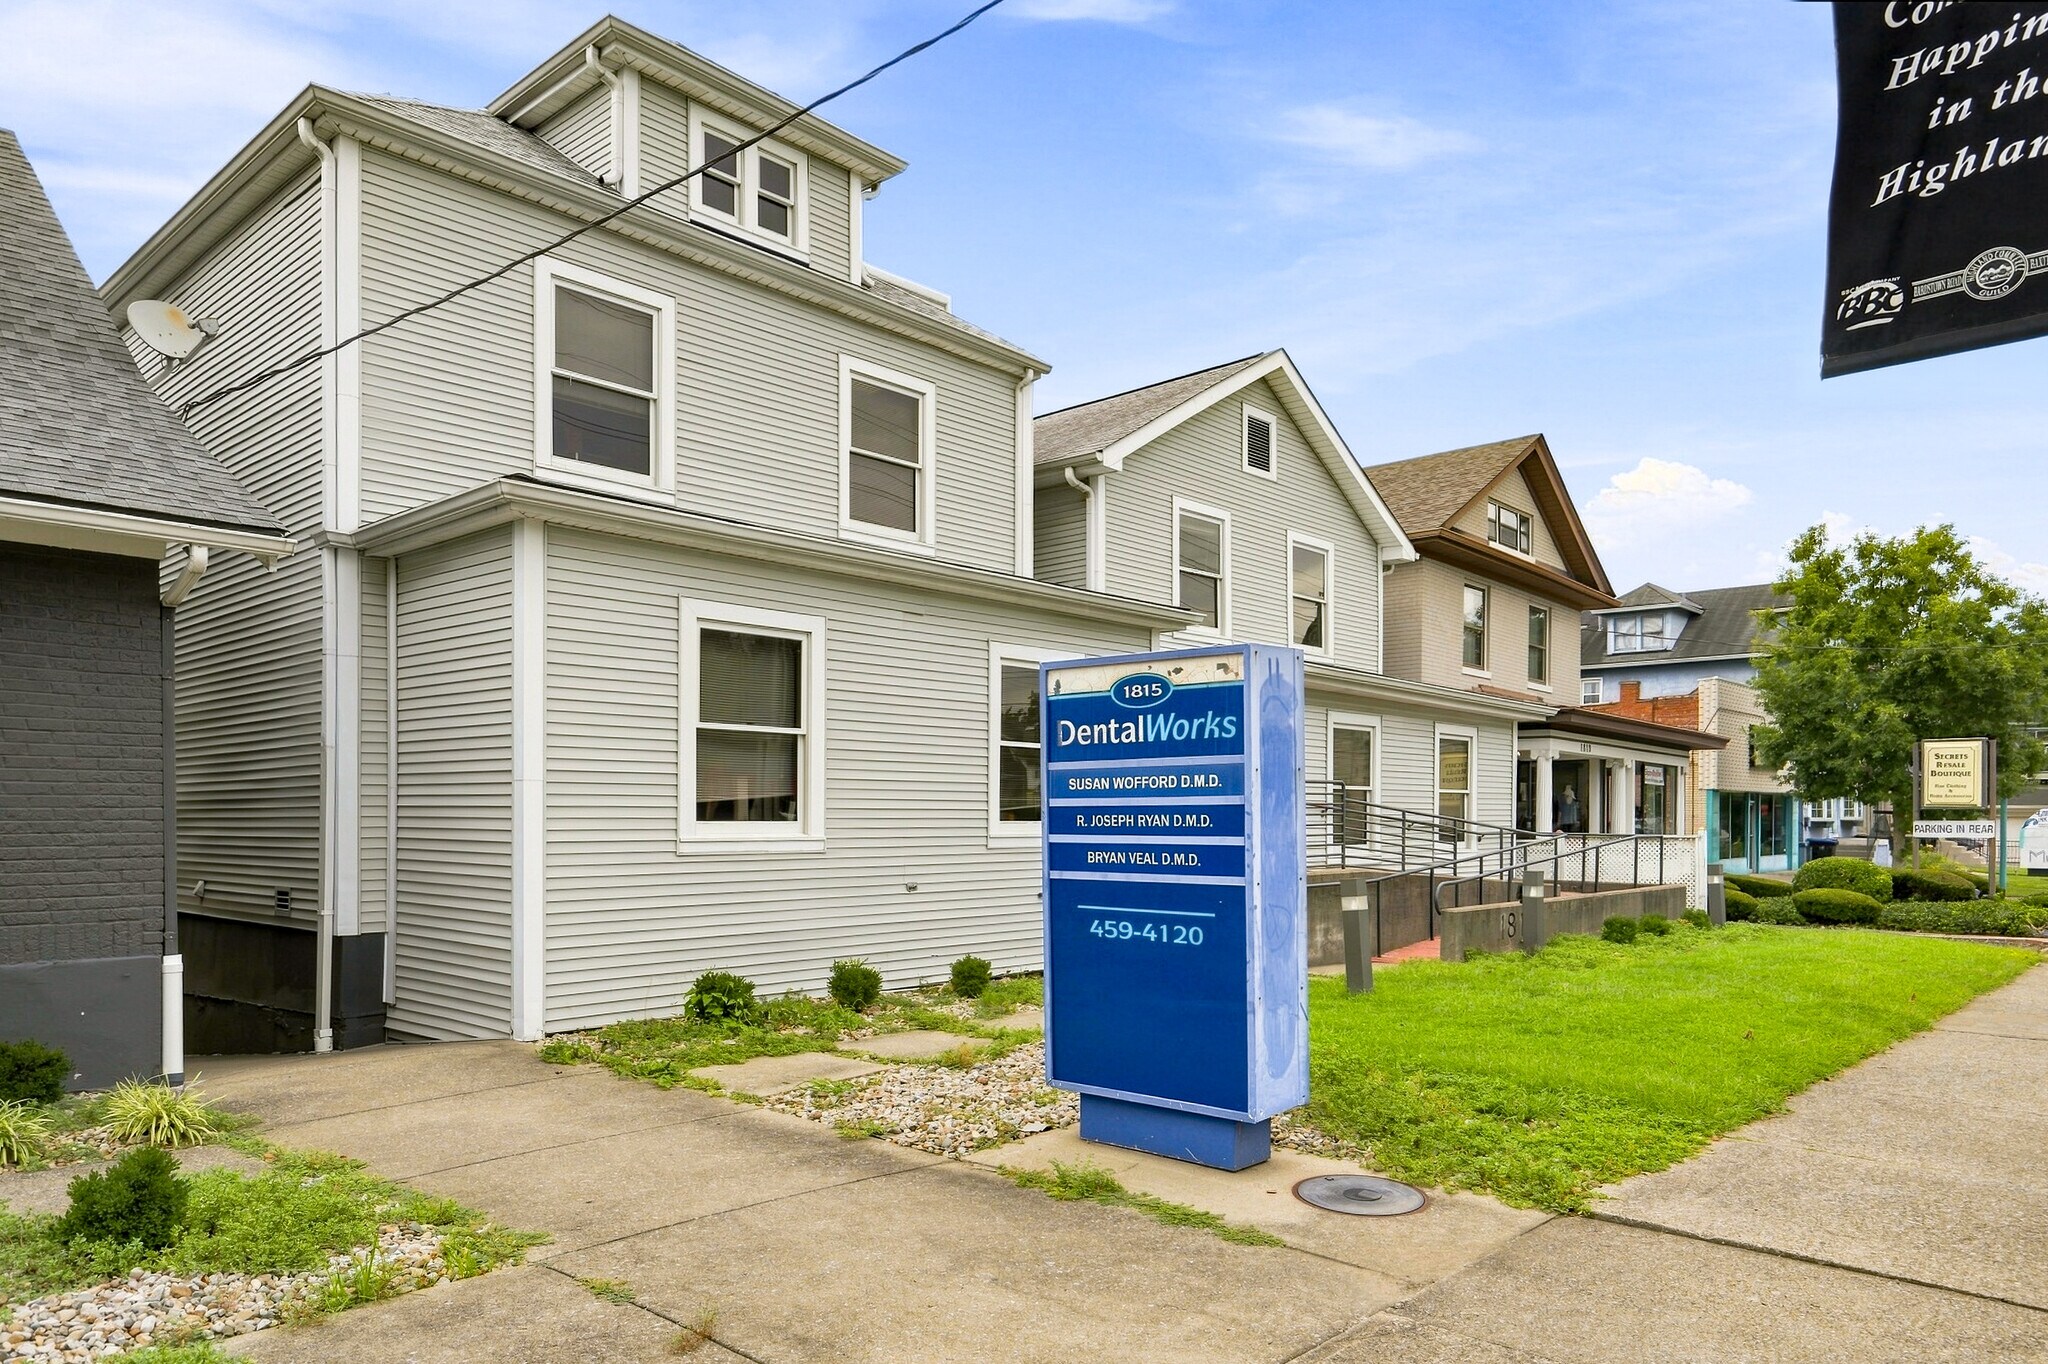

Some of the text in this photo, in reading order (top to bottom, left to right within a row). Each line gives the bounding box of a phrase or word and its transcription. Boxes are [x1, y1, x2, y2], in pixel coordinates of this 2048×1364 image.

[1884, 2, 1965, 29] Co
[1928, 97, 1971, 130] in
[1978, 284, 2010, 297] GUILD
[1122, 682, 1163, 699] 1815
[1057, 710, 1237, 747] DentalWorks
[1068, 774, 1222, 791] SUSAN WOFFORD D.M.D.
[1076, 814, 1213, 828] R. JOSEPH RYAN D.M.D.
[1913, 824, 1994, 834] PARKING IN REAR
[1087, 851, 1201, 867] BRYAN VEAL D.M.D.
[1089, 918, 1204, 946] 459-4120
